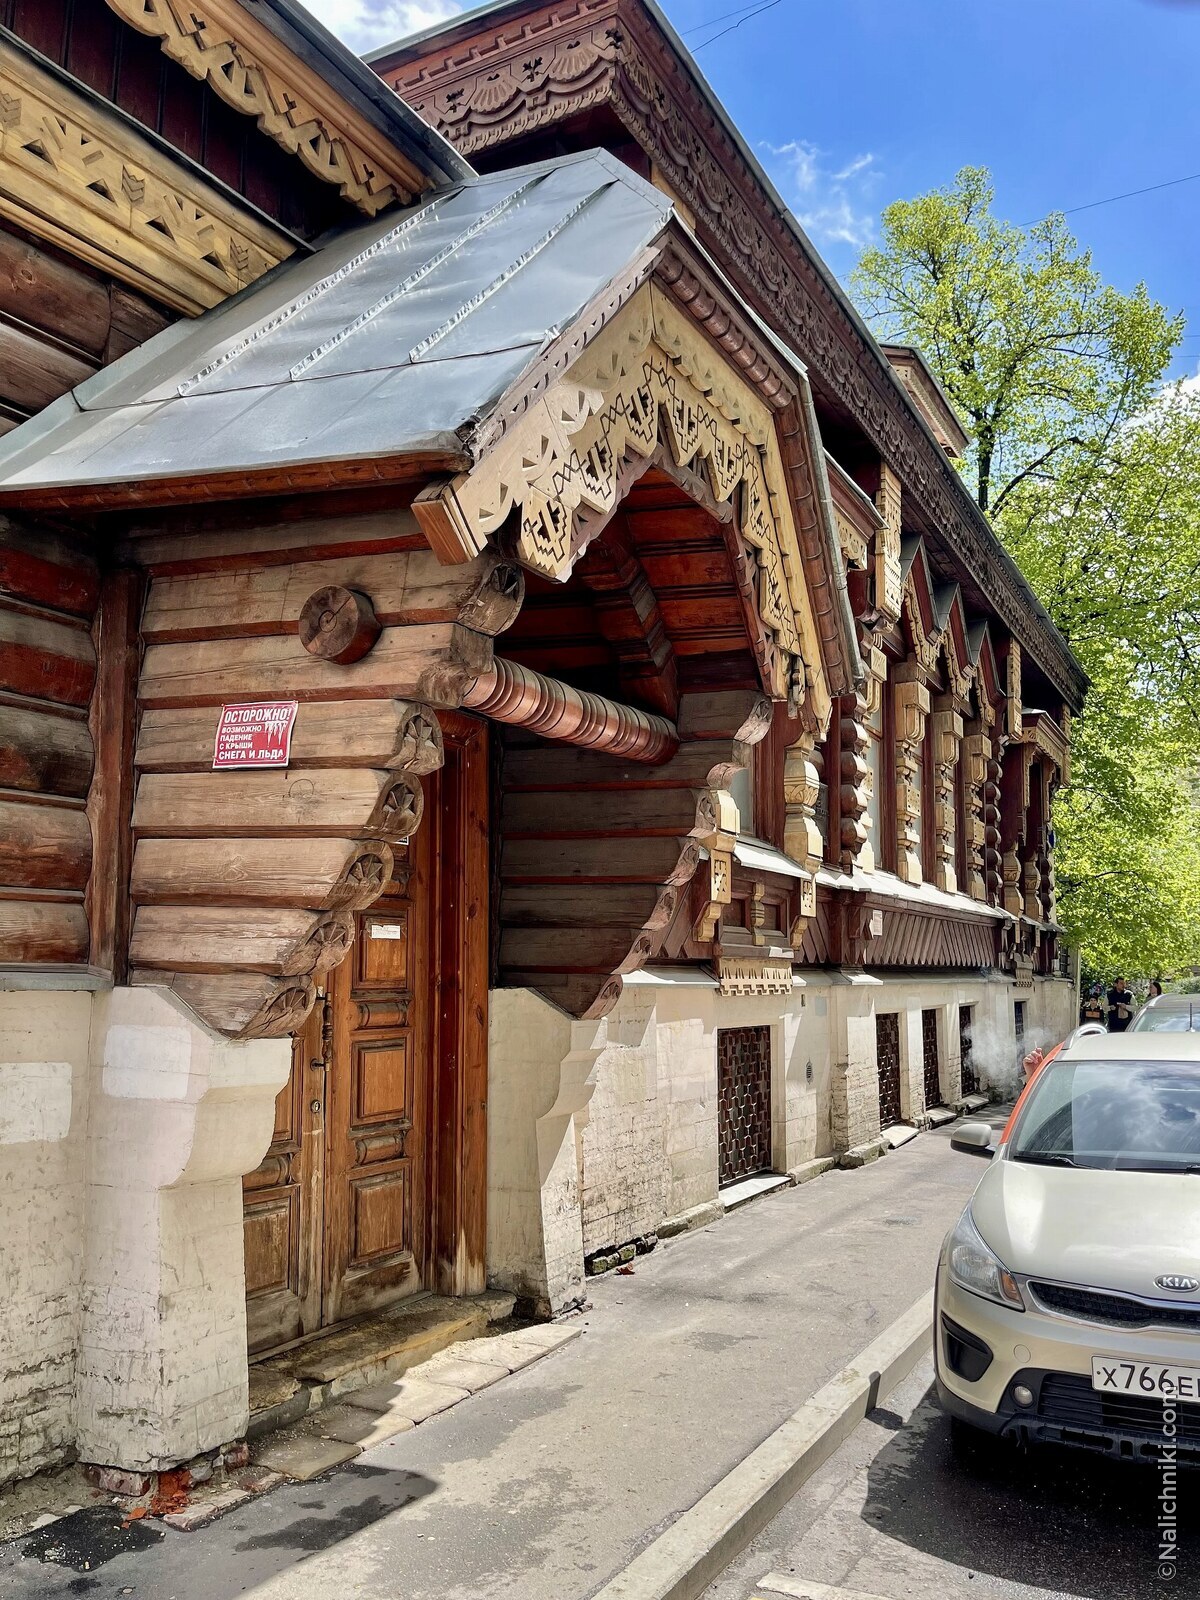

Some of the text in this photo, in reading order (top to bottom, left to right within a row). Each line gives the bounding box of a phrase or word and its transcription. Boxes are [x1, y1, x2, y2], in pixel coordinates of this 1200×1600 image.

[224, 708, 292, 723] ОСТОРОЖНО!
[221, 725, 262, 733] ВОЗМОЖНО
[220, 734, 253, 742] ПАДЕНИЕ
[225, 742, 253, 750] КРЫШИ
[218, 749, 284, 760] СНЕГА И ЛЬДА
[1162, 1276, 1192, 1288] KIA
[1102, 1363, 1200, 1398] Х766Е
